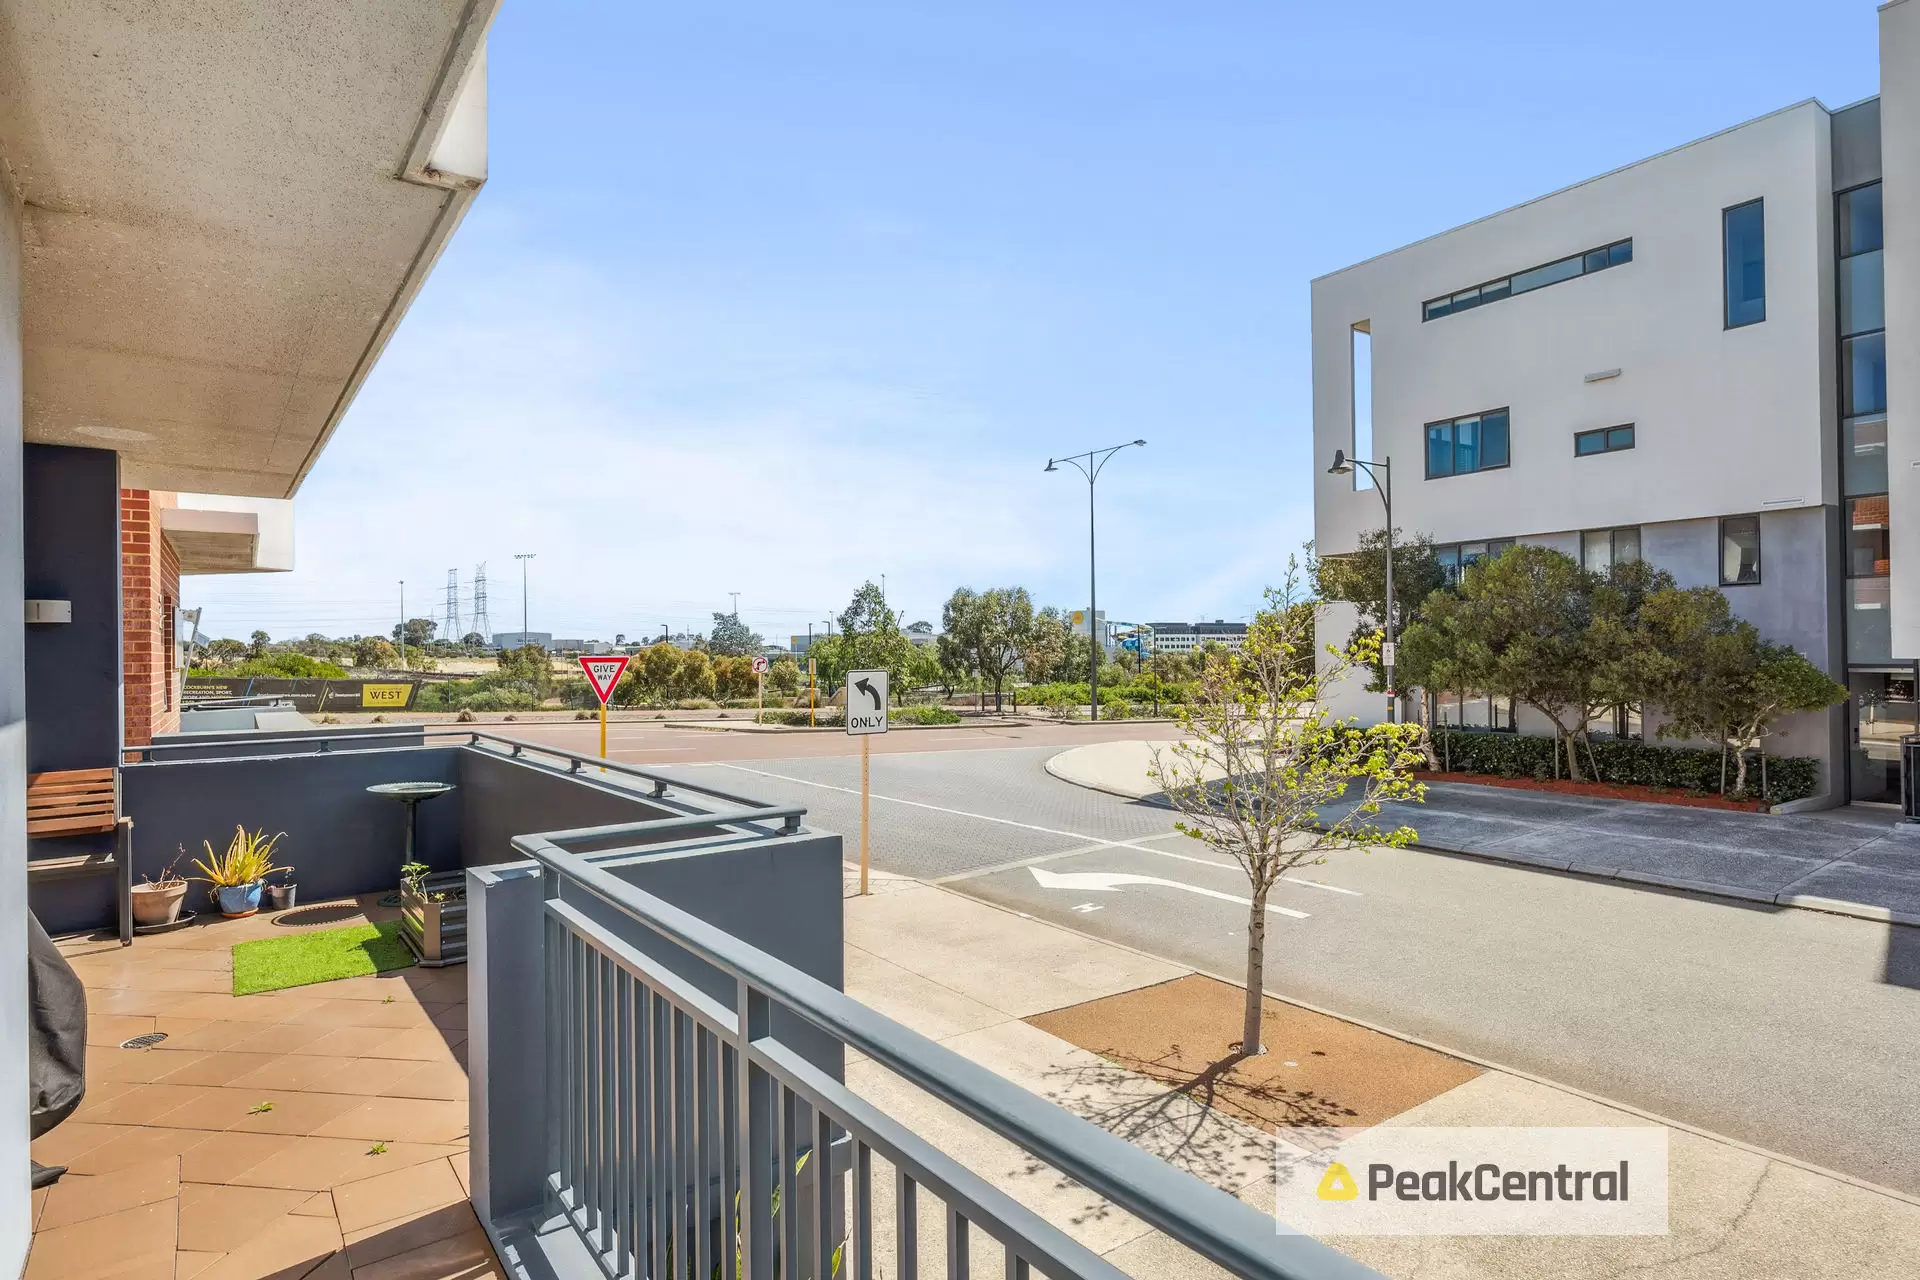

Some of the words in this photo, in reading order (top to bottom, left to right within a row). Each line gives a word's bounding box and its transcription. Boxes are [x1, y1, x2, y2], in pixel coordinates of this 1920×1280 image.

[593, 664, 616, 673] GIVE
[369, 691, 402, 700] WEST
[851, 716, 883, 728] ONLY
